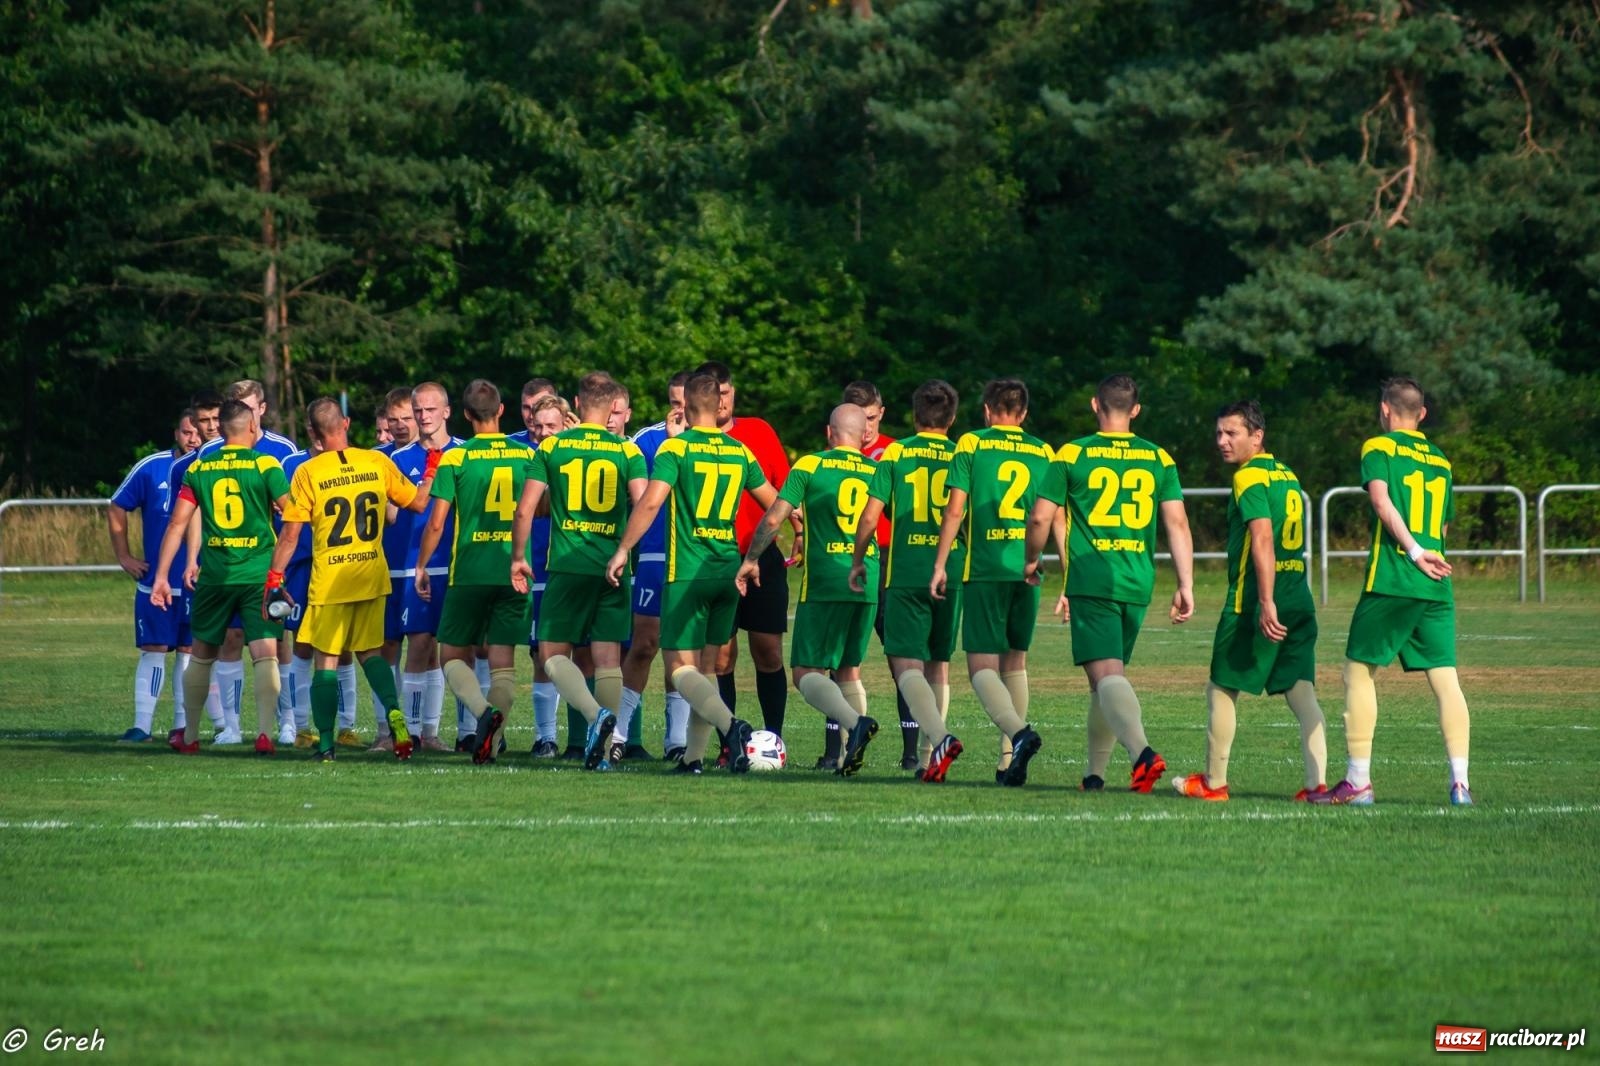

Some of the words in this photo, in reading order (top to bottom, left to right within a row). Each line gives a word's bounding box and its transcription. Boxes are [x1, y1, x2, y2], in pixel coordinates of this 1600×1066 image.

[351, 471, 379, 484] ZAWADA
[938, 451, 953, 462] ZAW
[213, 478, 244, 529] 6
[484, 466, 517, 521] 4
[560, 458, 617, 512] 10
[694, 461, 742, 520] 77
[837, 478, 869, 534] 9
[998, 460, 1030, 520] 2
[1088, 467, 1155, 529] 23
[1403, 470, 1446, 540] 11
[324, 491, 379, 547] 26
[472, 531, 512, 542] LSM-SPO
[986, 527, 1026, 540] LSM-SPO
[1282, 489, 1303, 551] 8
[287, 603, 301, 621] 0
[401, 607, 409, 626] 4
[639, 587, 655, 607] 17
